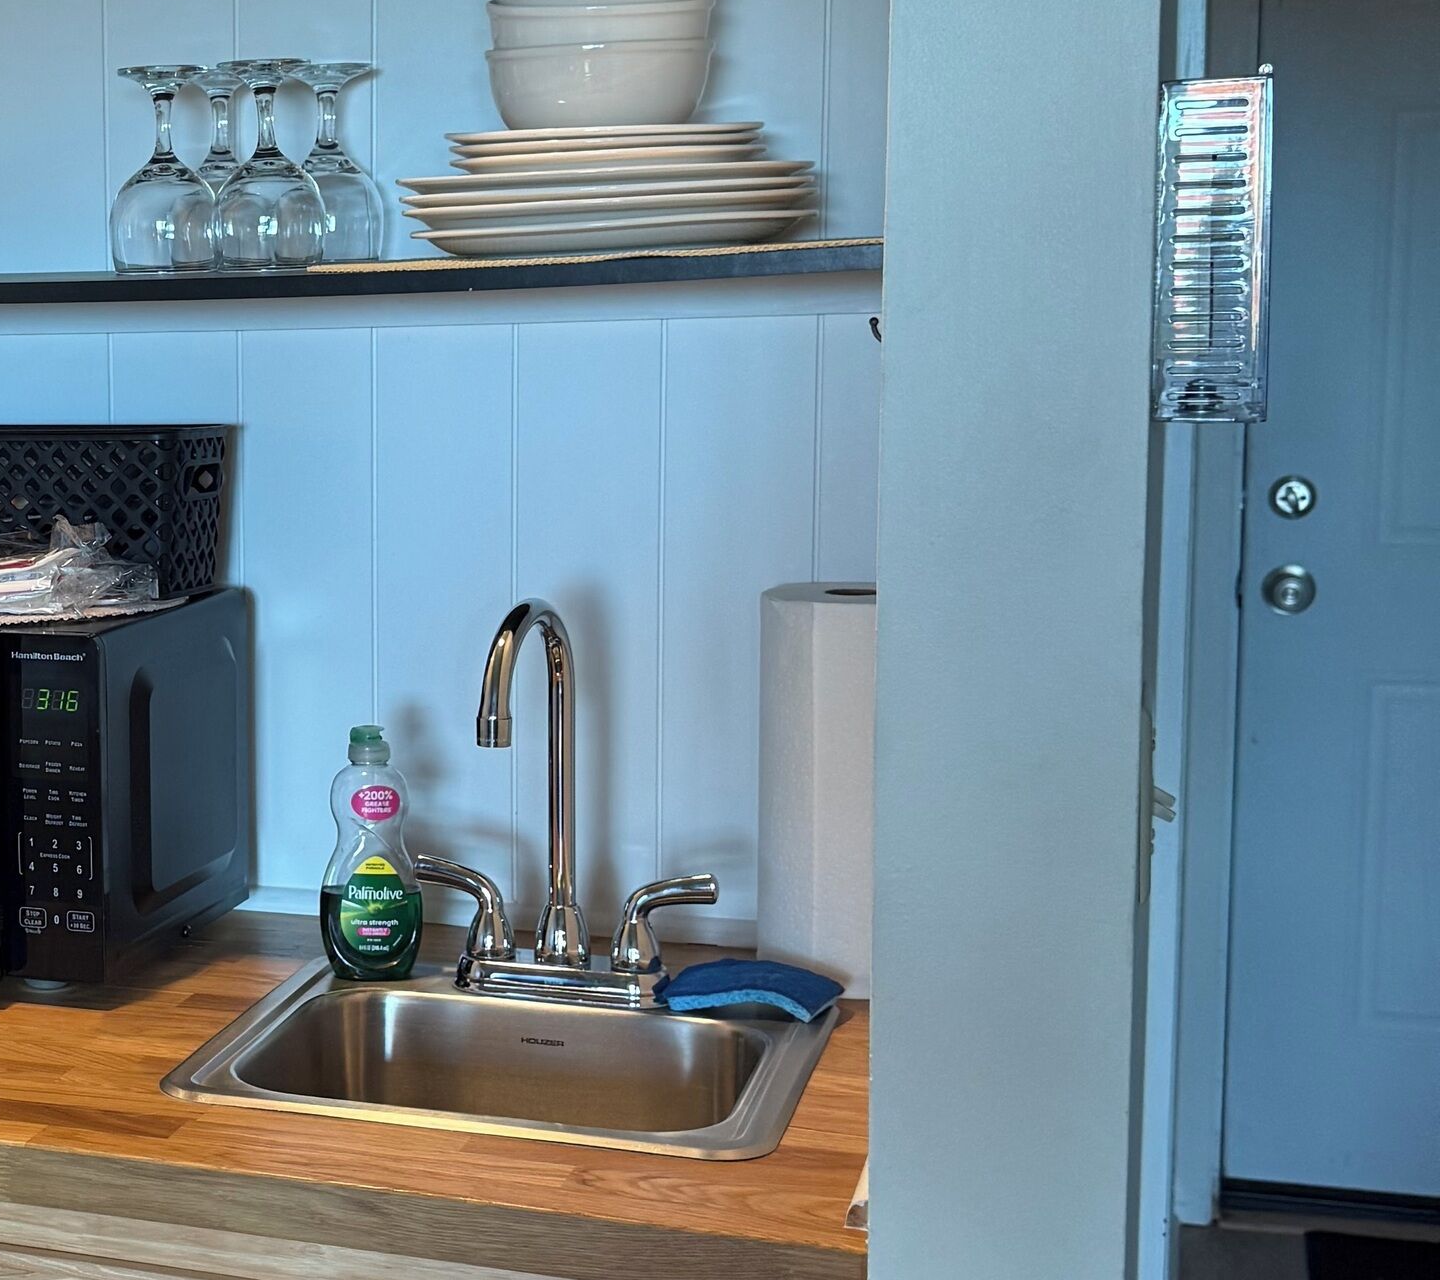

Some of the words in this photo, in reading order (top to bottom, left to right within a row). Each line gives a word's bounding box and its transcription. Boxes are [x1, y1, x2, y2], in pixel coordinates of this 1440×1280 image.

[11, 651, 53, 660] Hamilton
[54, 653, 83, 661] Beach
[359, 790, 393, 801] +200%
[29, 838, 34, 847] 1
[52, 839, 58, 849] 2
[76, 841, 82, 850] 3
[29, 862, 35, 871] 4
[53, 863, 58, 872] 5
[77, 865, 82, 874] 6
[29, 886, 35, 895] 7
[53, 888, 59, 897] 8
[77, 890, 83, 899] 9
[348, 885, 403, 900] Palmolive
[54, 915, 59, 924] 0
[368, 919, 399, 927] strength
